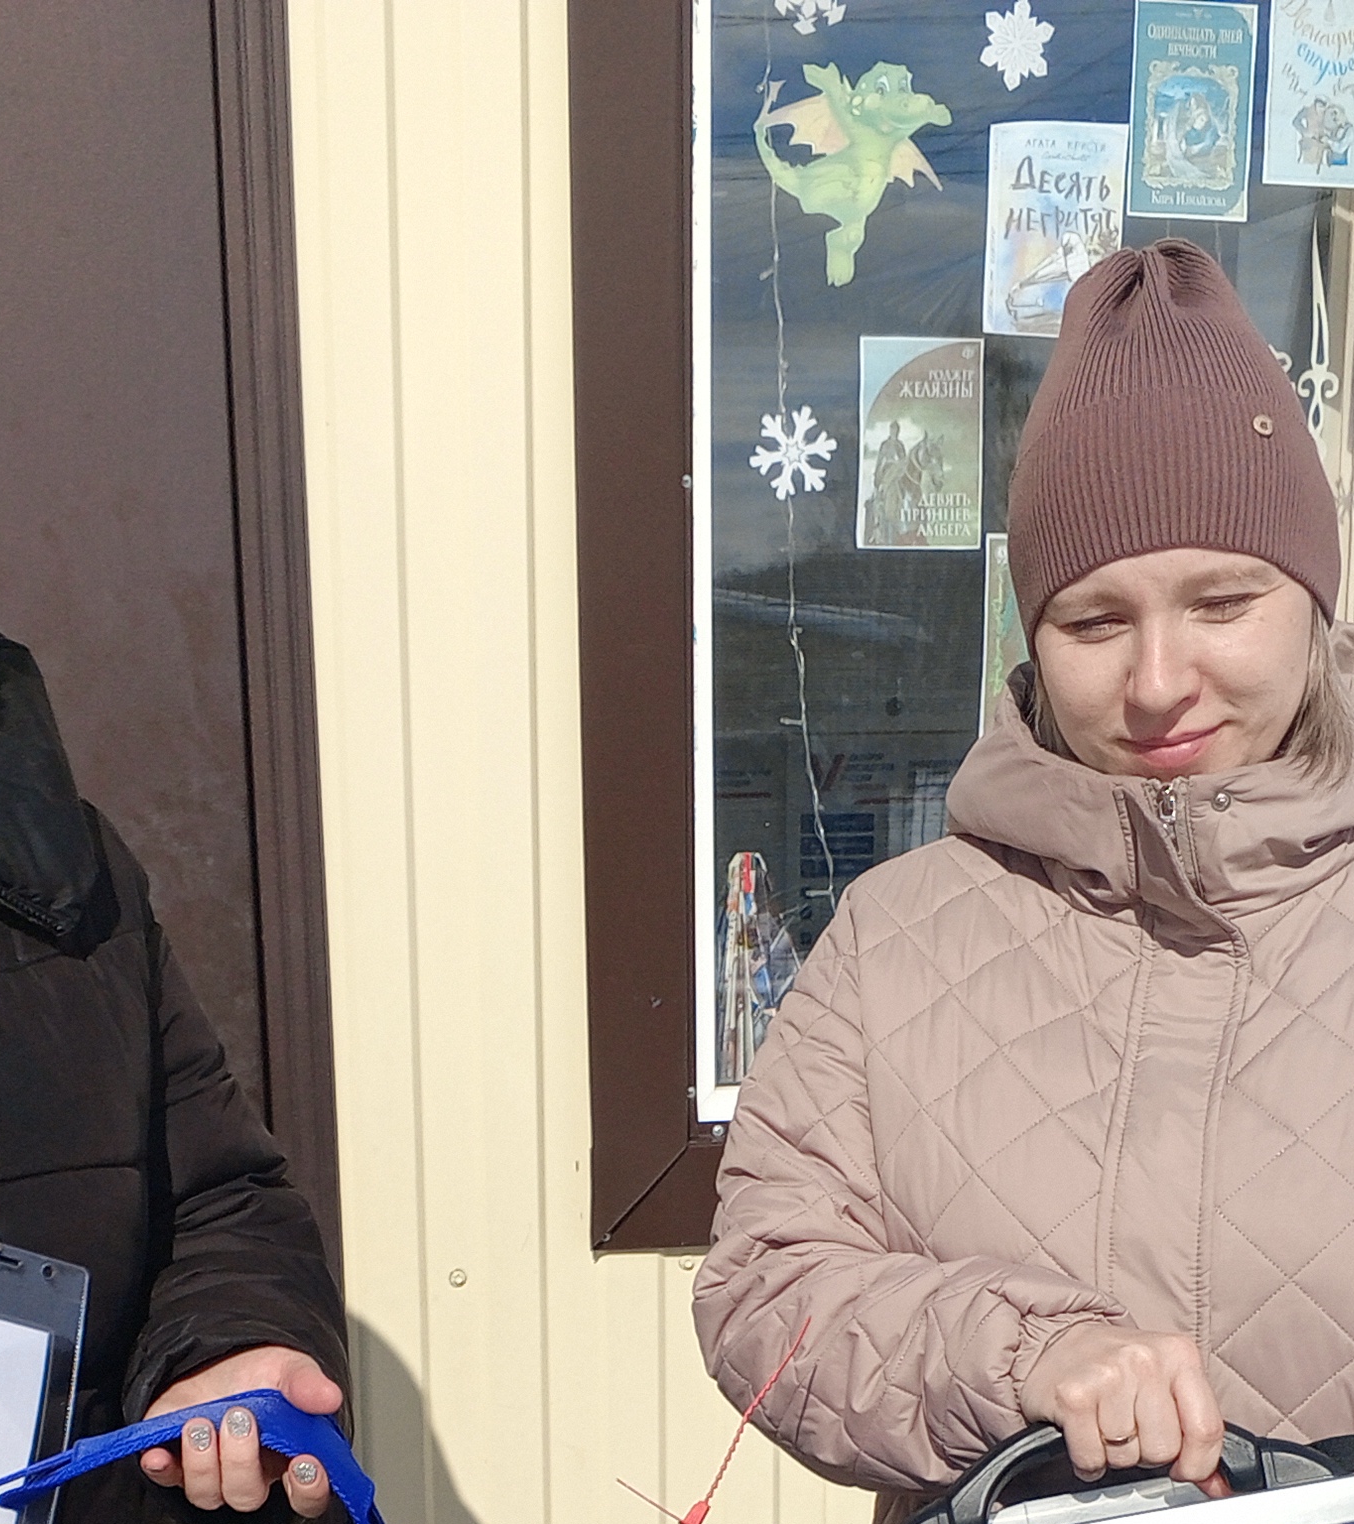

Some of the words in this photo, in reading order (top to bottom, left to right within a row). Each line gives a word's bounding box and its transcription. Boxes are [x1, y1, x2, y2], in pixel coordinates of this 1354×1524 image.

[899, 380, 974, 399] ЖЕЛЯЗНЫ
[917, 493, 971, 508] ДЕВЯТЬ
[916, 522, 971, 538] АМБЕРА
